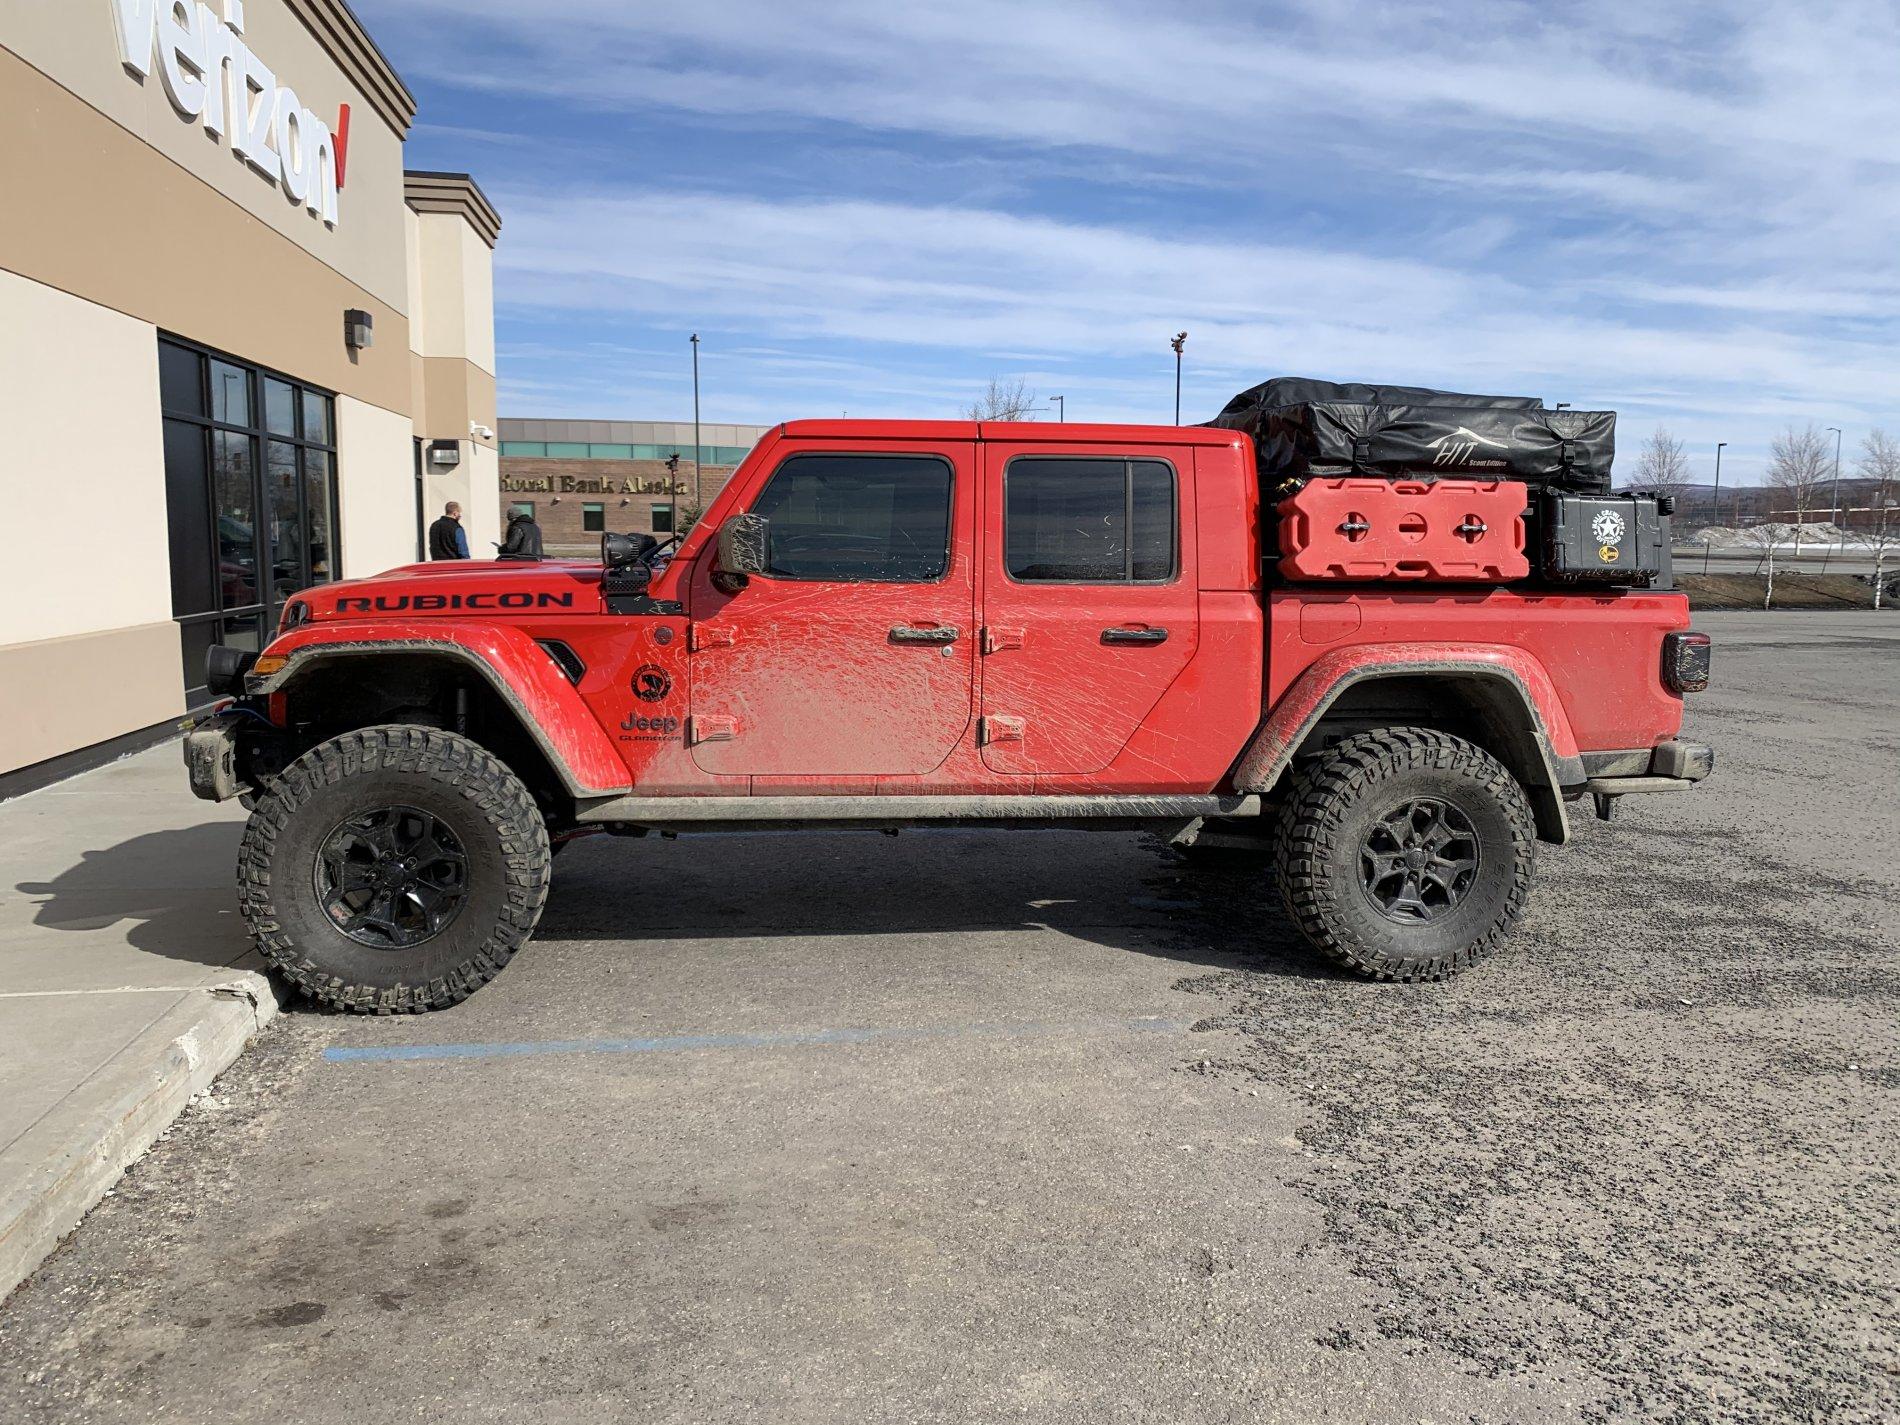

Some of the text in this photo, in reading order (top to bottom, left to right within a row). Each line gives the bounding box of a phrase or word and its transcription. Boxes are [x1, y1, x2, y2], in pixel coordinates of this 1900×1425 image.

[1433, 441, 1479, 466] HIT
[498, 474, 689, 496] ional Bank Alaska
[336, 592, 574, 612] RUBICON
[620, 712, 678, 734] Jeep
